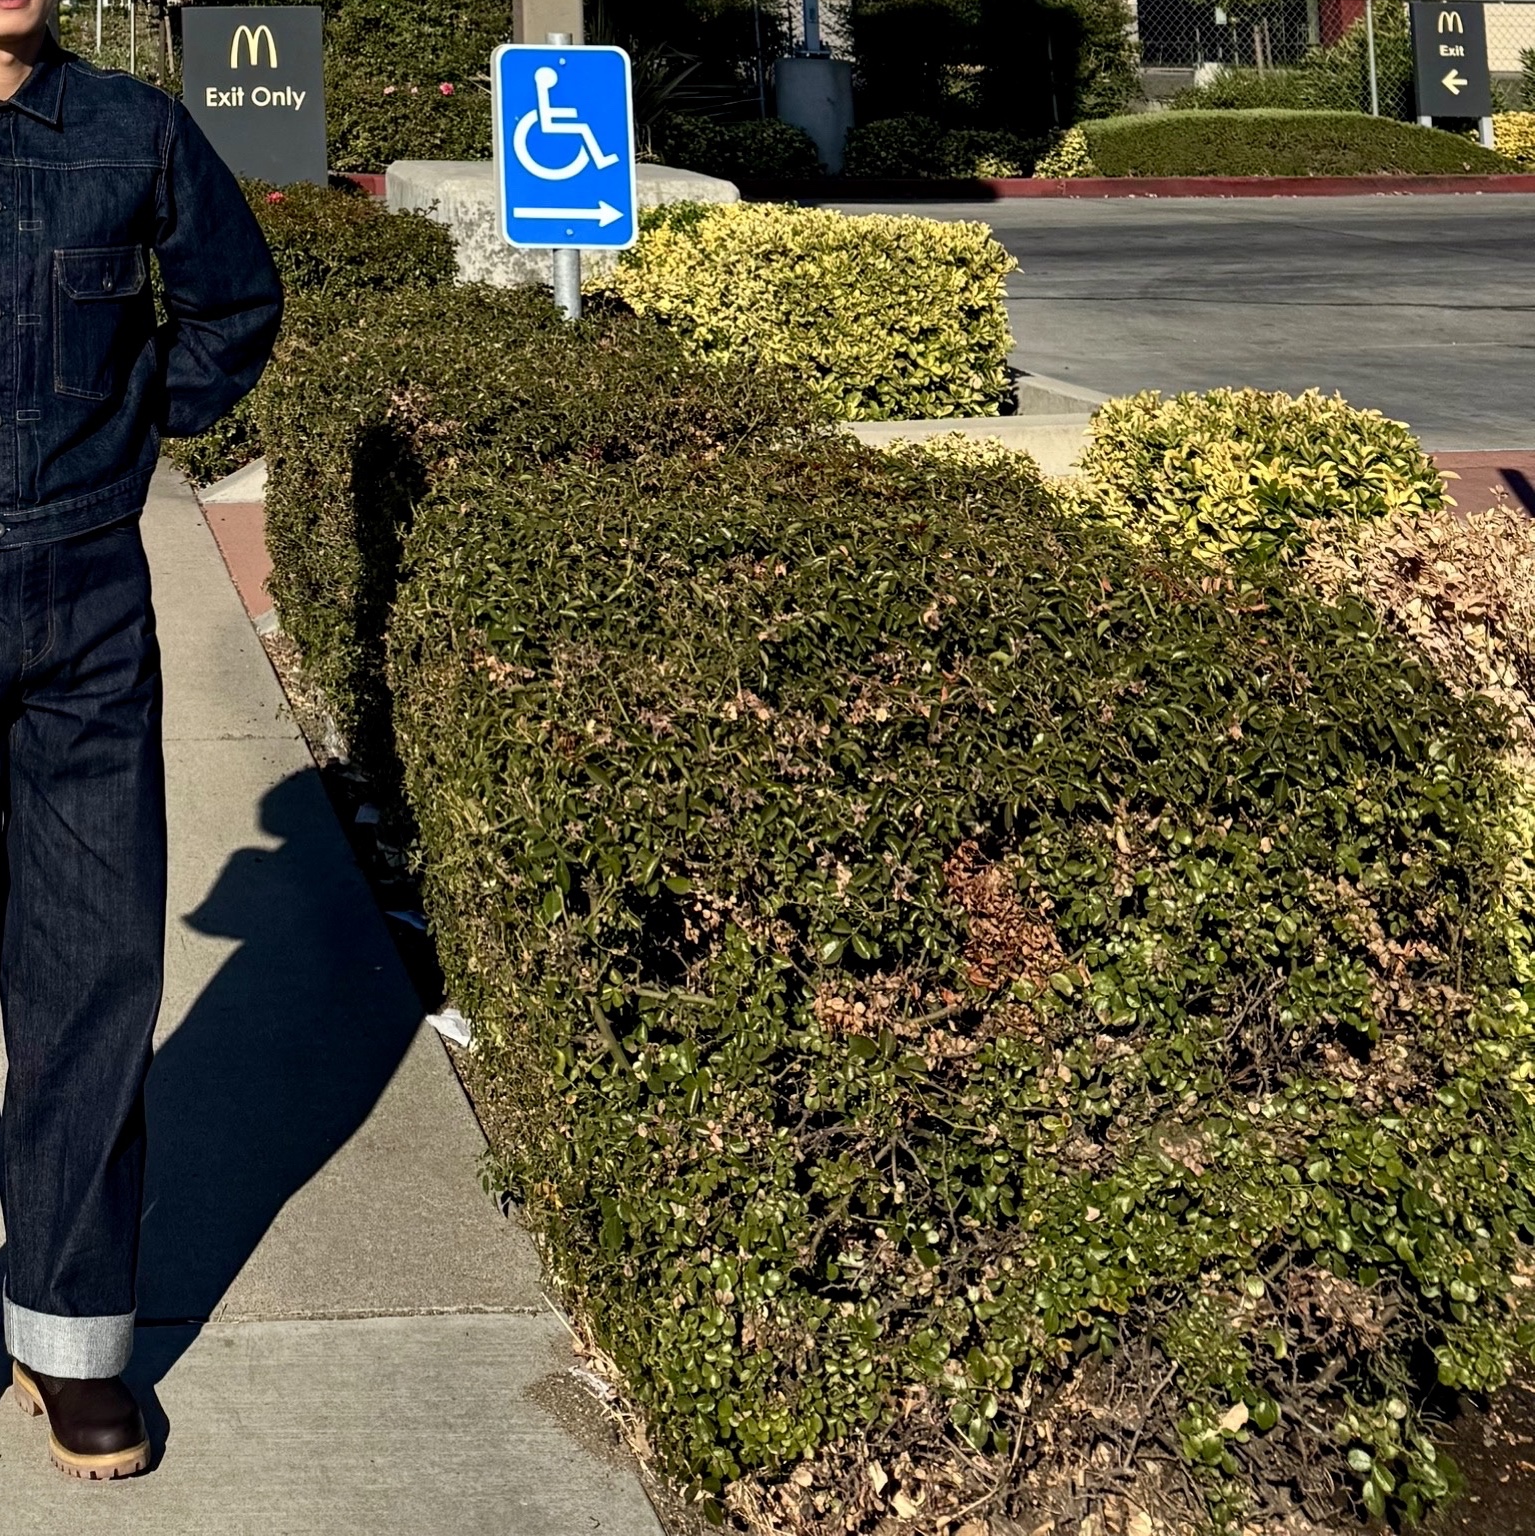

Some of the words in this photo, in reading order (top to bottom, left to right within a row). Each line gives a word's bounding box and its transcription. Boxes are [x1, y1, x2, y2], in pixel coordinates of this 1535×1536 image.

[1439, 45, 1465, 57] Exit
[205, 86, 245, 107] Exit
[250, 85, 307, 111] Only
